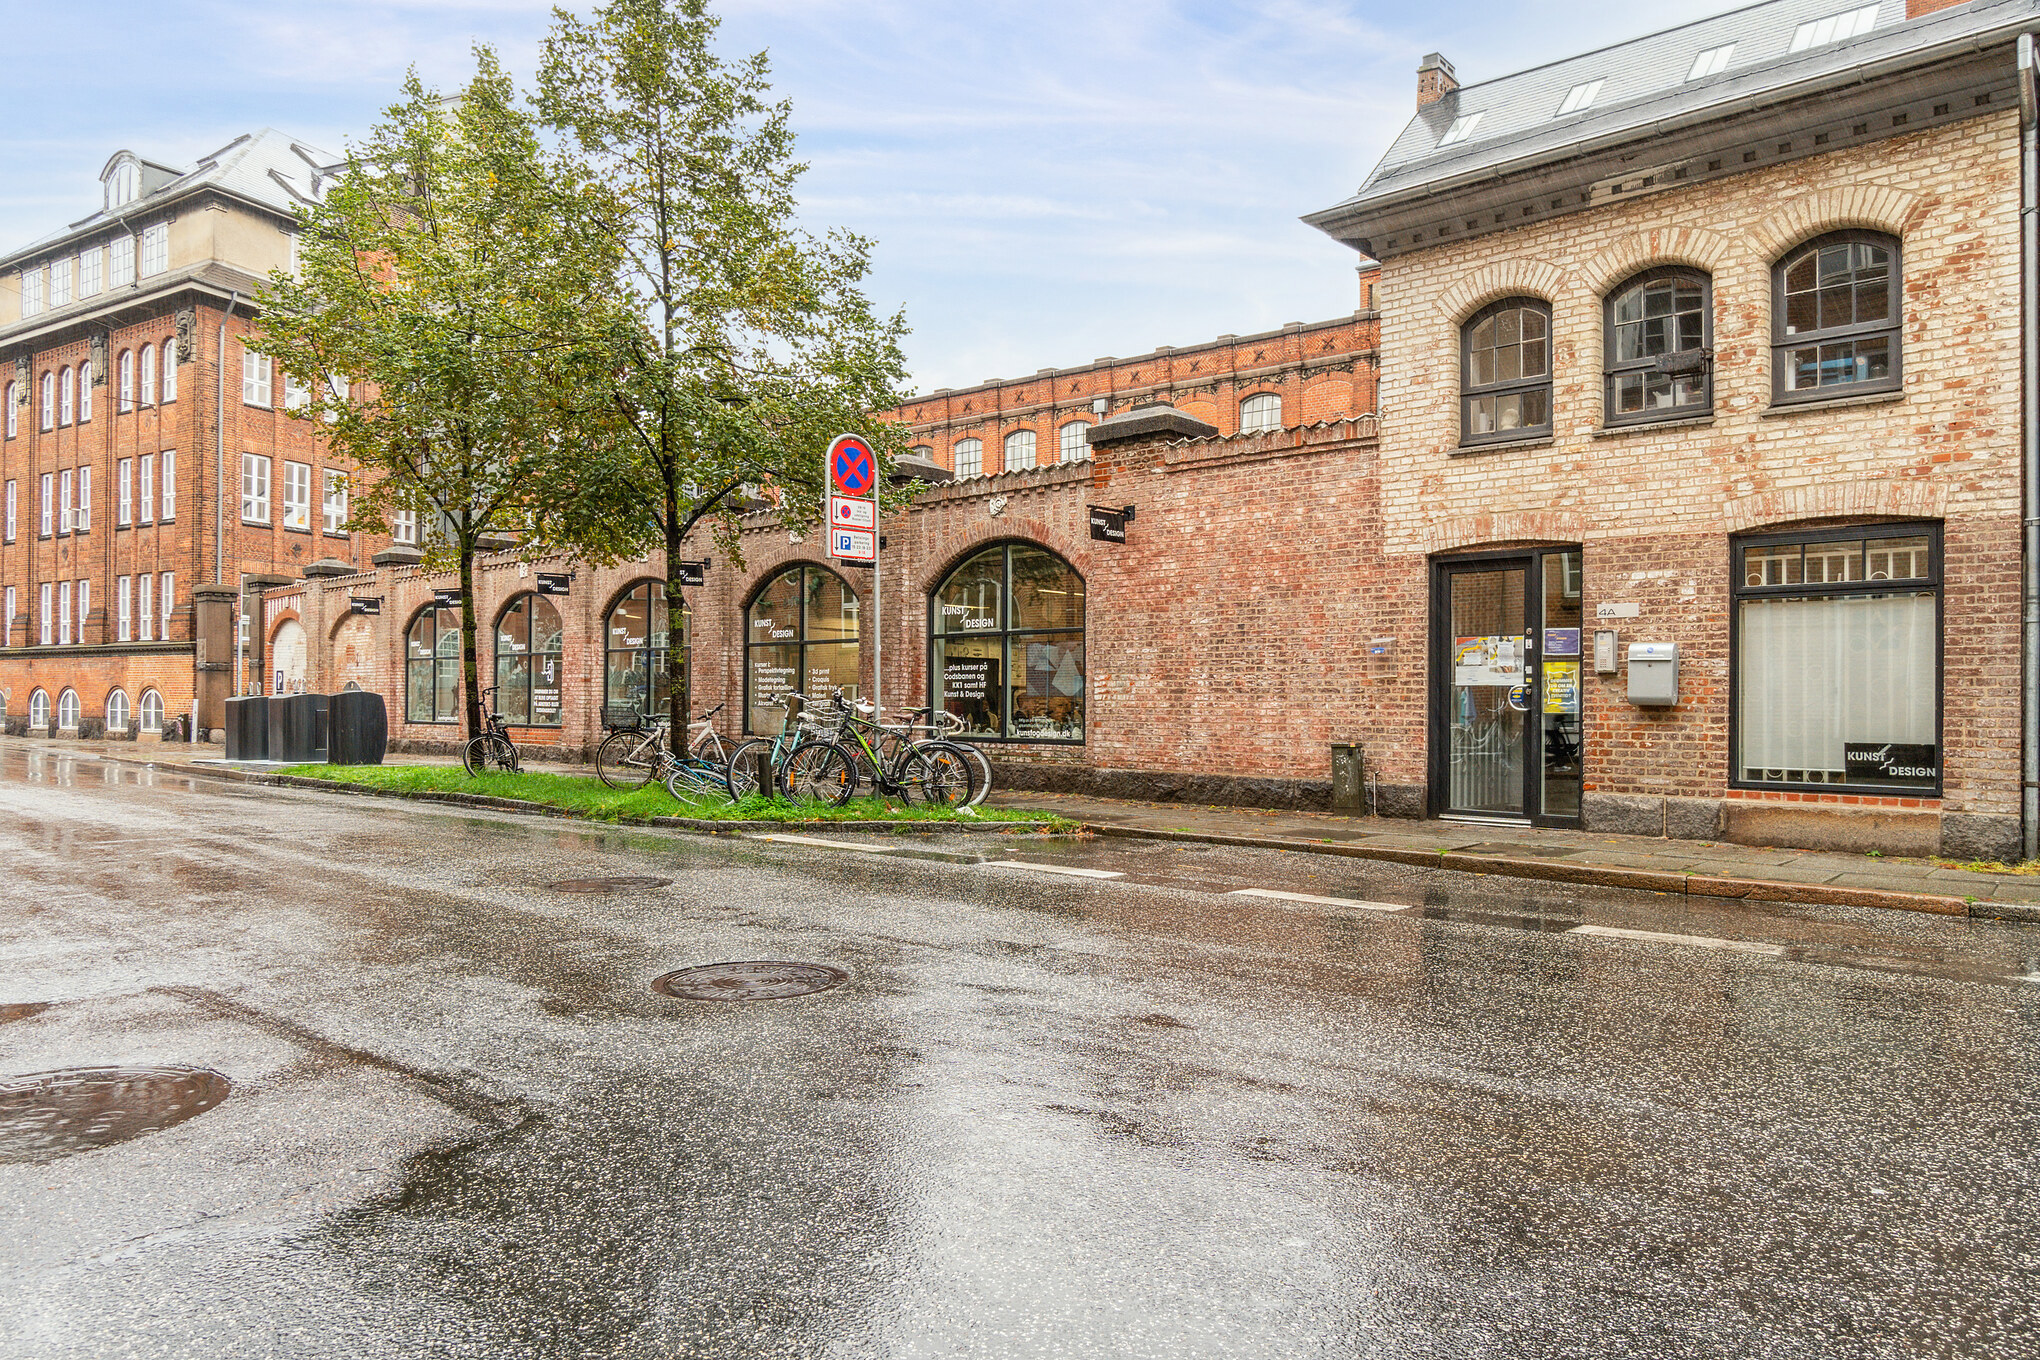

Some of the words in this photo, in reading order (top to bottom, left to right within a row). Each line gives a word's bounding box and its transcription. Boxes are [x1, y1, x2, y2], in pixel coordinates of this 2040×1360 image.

[1091, 518, 1106, 526] KUNST
[942, 606, 964, 615] KUNST
[755, 619, 772, 627] KUNST
[966, 618, 994, 628] DESIGN
[772, 630, 794, 638] DESIGN
[980, 662, 988, 671] på
[965, 691, 984, 699] Design
[1847, 752, 1886, 761] KUNST
[1889, 767, 1935, 776] DESIGN
